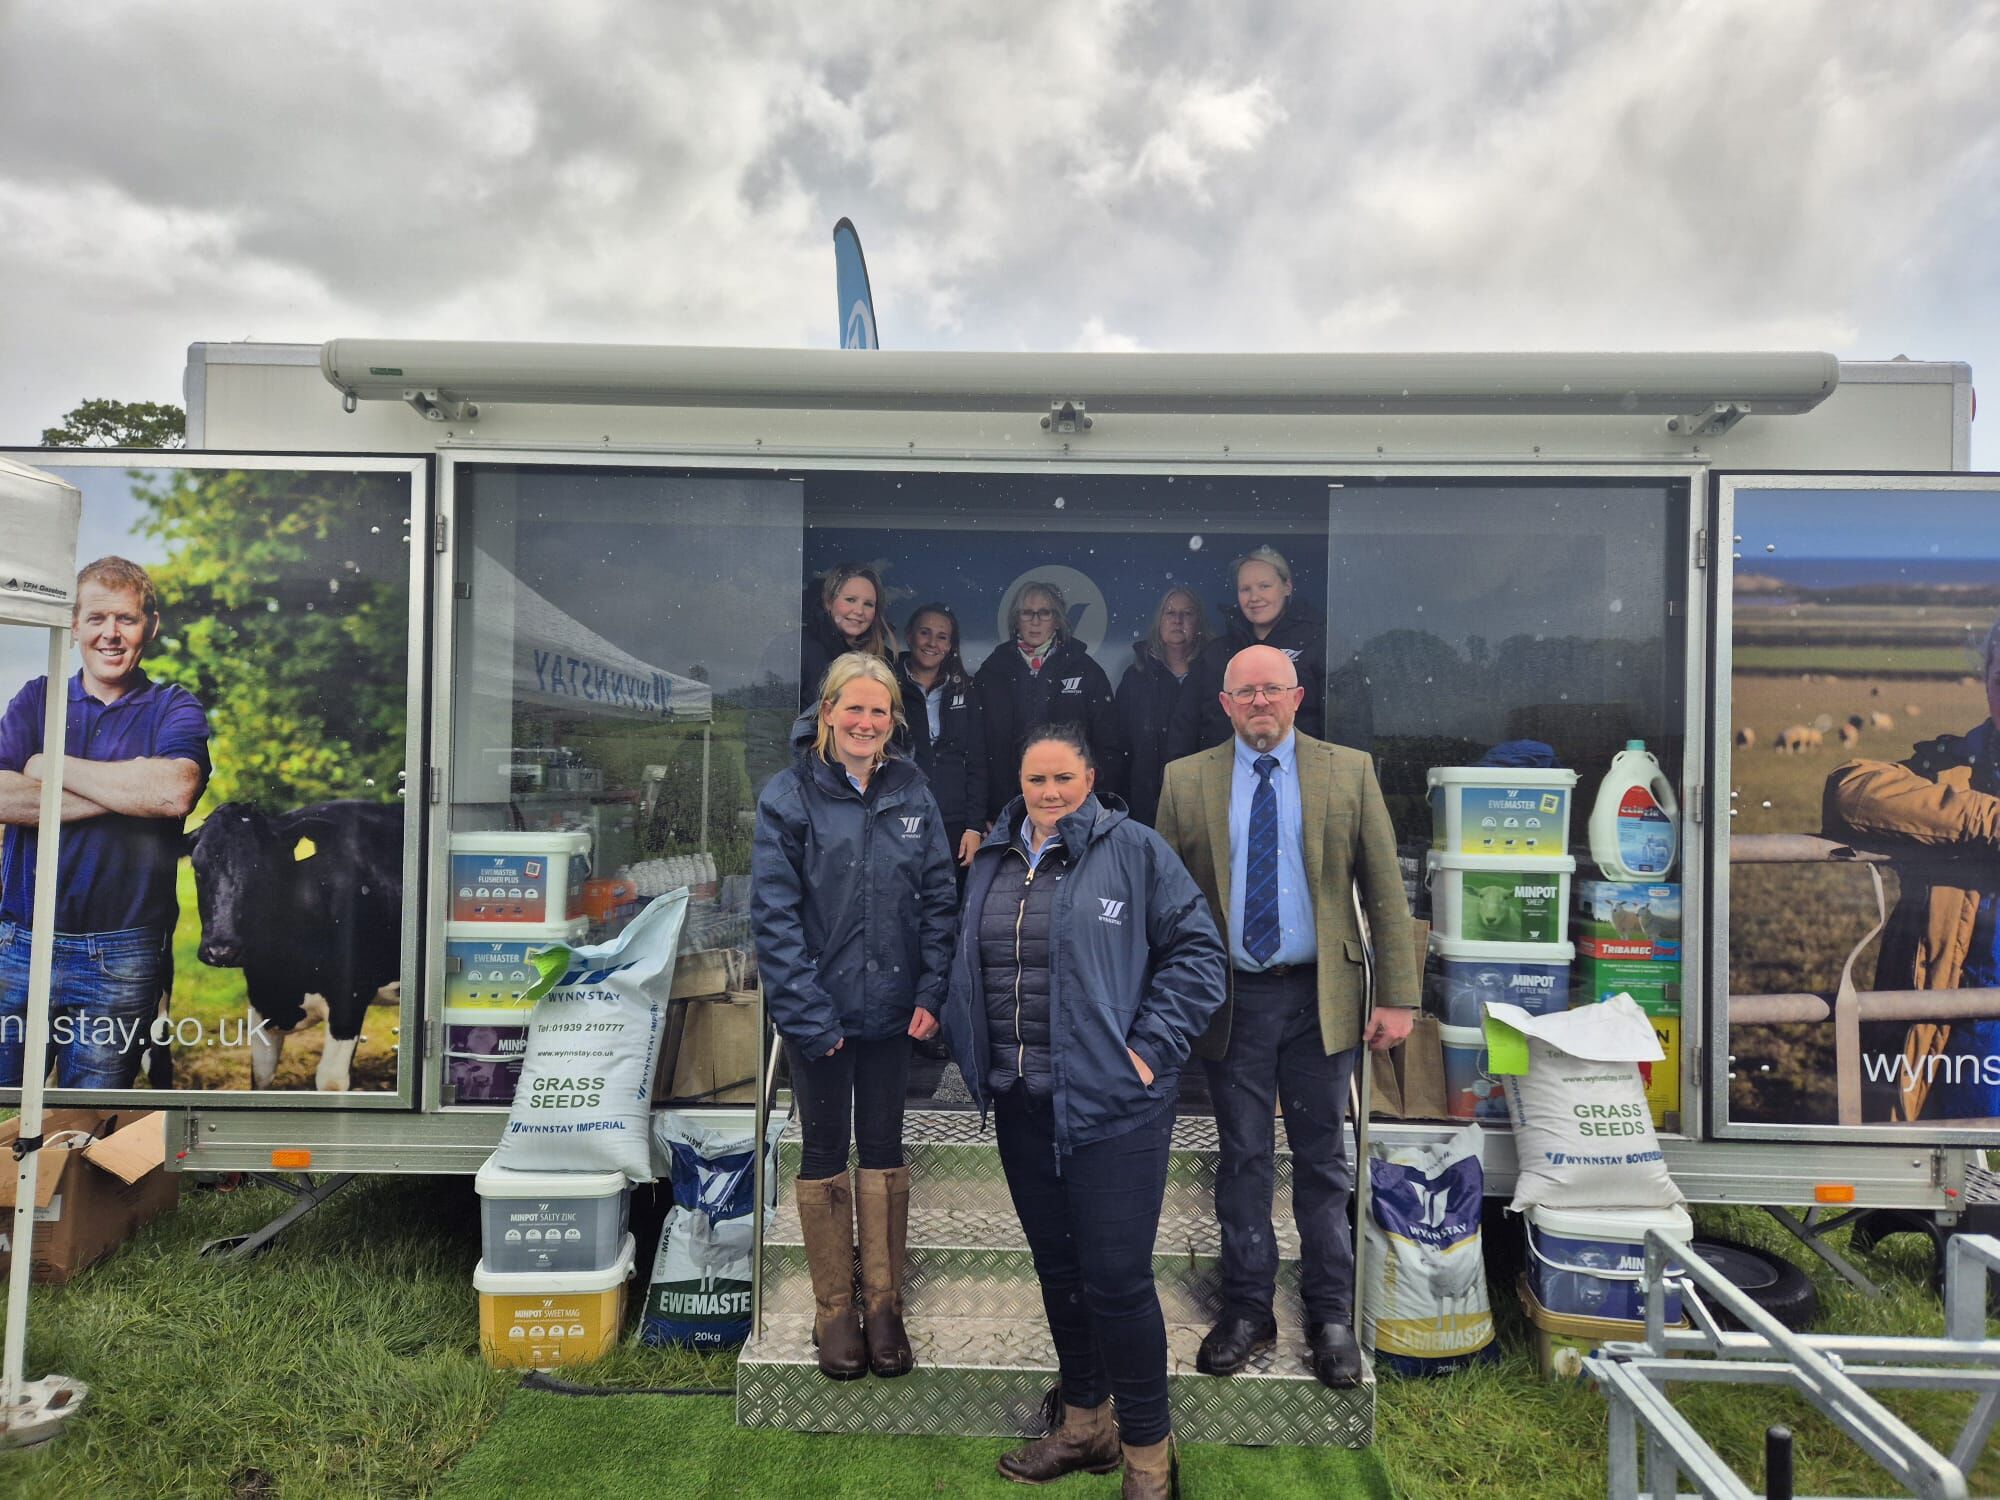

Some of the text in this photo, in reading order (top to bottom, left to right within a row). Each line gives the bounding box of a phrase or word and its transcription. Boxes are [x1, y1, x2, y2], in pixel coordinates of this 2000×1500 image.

[1488, 800, 1536, 810] EWEMASTER
[1514, 886, 1557, 899] MINPOT
[474, 954, 519, 963] EWEMASTER
[1509, 975, 1556, 988] MINPOT
[548, 991, 621, 1003] WYNNSTAY
[0, 1008, 272, 1055] nstay.co.uk
[585, 1023, 625, 1032] 210777
[498, 1039, 528, 1052] MINP
[537, 1049, 614, 1058] www.wynnstay.co.uk
[532, 1077, 606, 1091] GRASS
[530, 1094, 601, 1109] SEEDS
[1573, 1104, 1643, 1119] GRASS
[521, 1121, 626, 1134] WYNNSTAY IMPERIAL
[1579, 1121, 1646, 1137] SEEDS
[1566, 1155, 1623, 1165] WYNNSTAY
[510, 1213, 577, 1222] MINPOT SALTY ZINC
[1617, 1256, 1645, 1271] MIN
[660, 1290, 753, 1315] EWEMASTE
[515, 1310, 542, 1318] MINPOT
[544, 1309, 565, 1318] SWEET
[694, 1331, 721, 1343] 20kg
